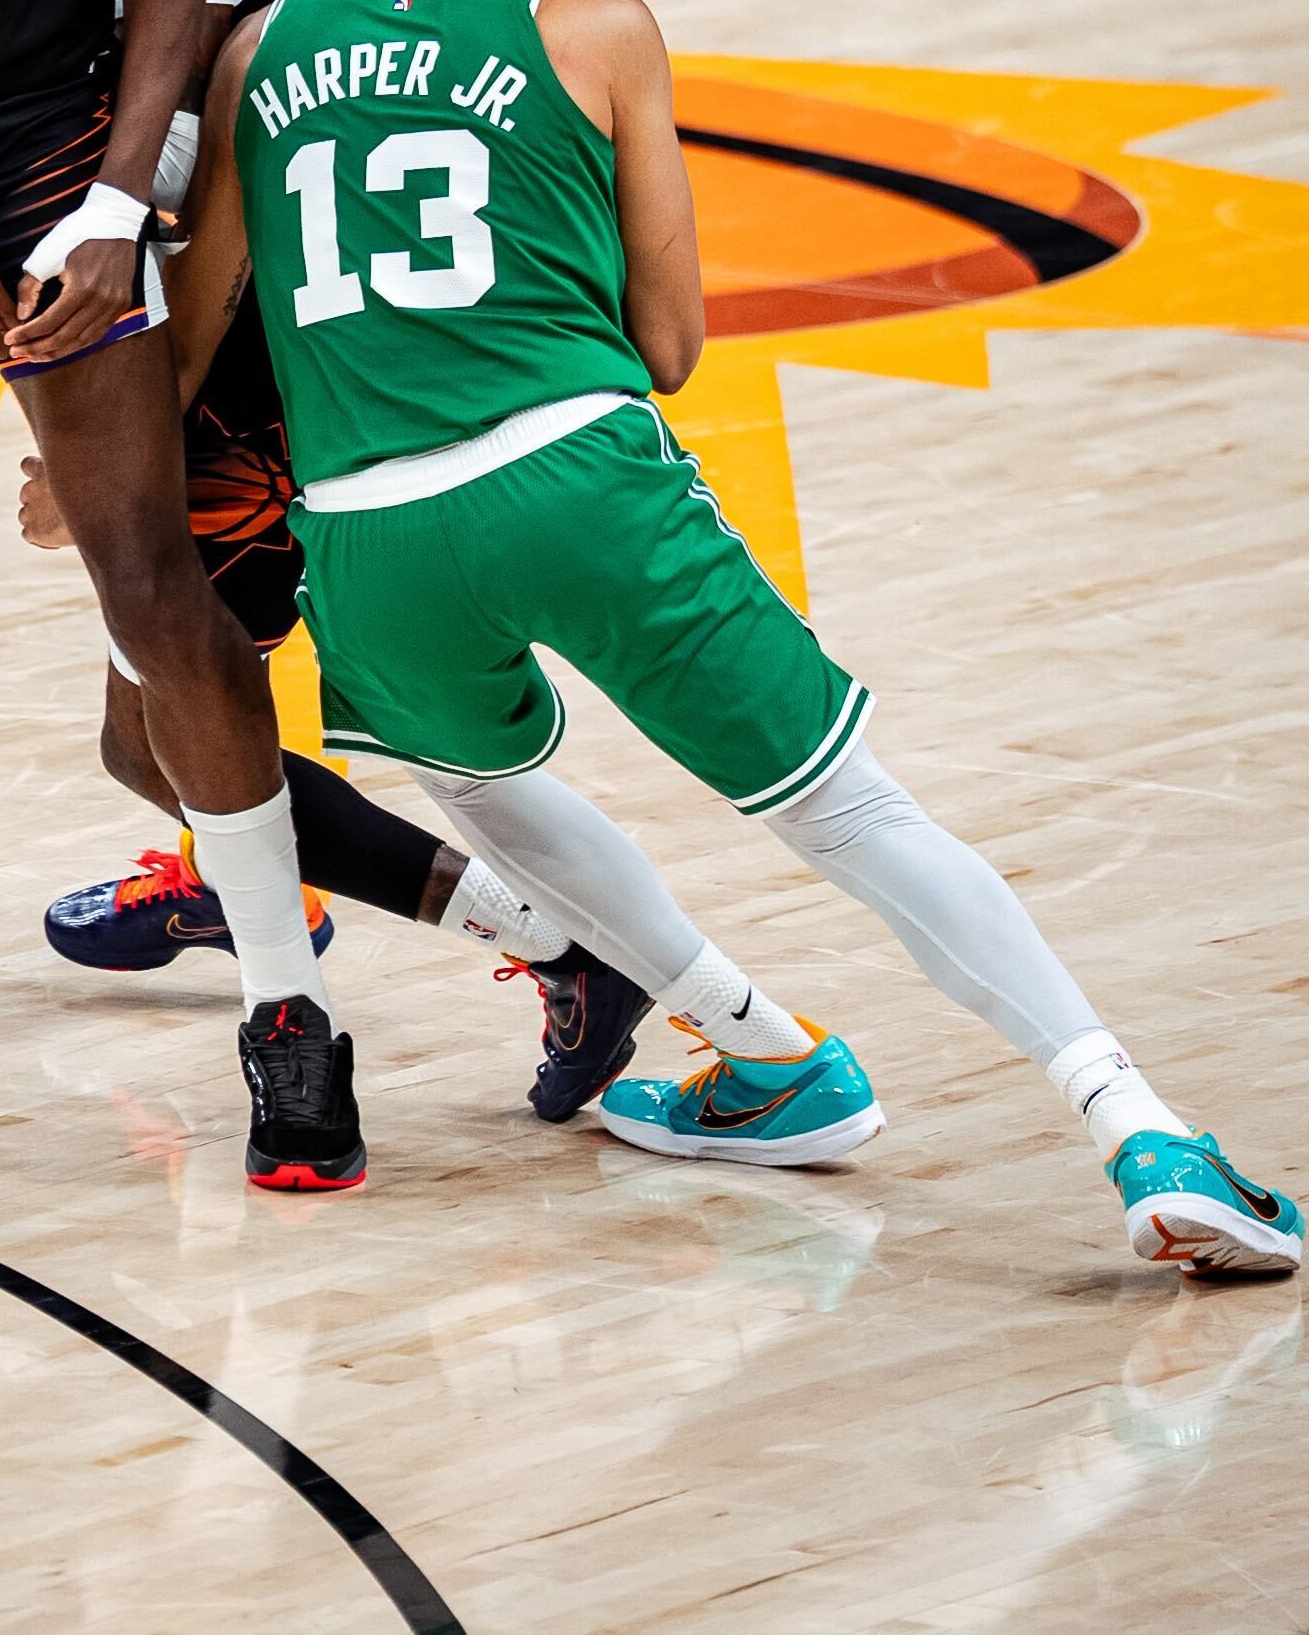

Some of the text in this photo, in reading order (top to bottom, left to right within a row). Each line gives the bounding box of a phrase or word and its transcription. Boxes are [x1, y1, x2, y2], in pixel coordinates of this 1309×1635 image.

[249, 39, 528, 138] HARPER JR.
[284, 128, 497, 328] 13
